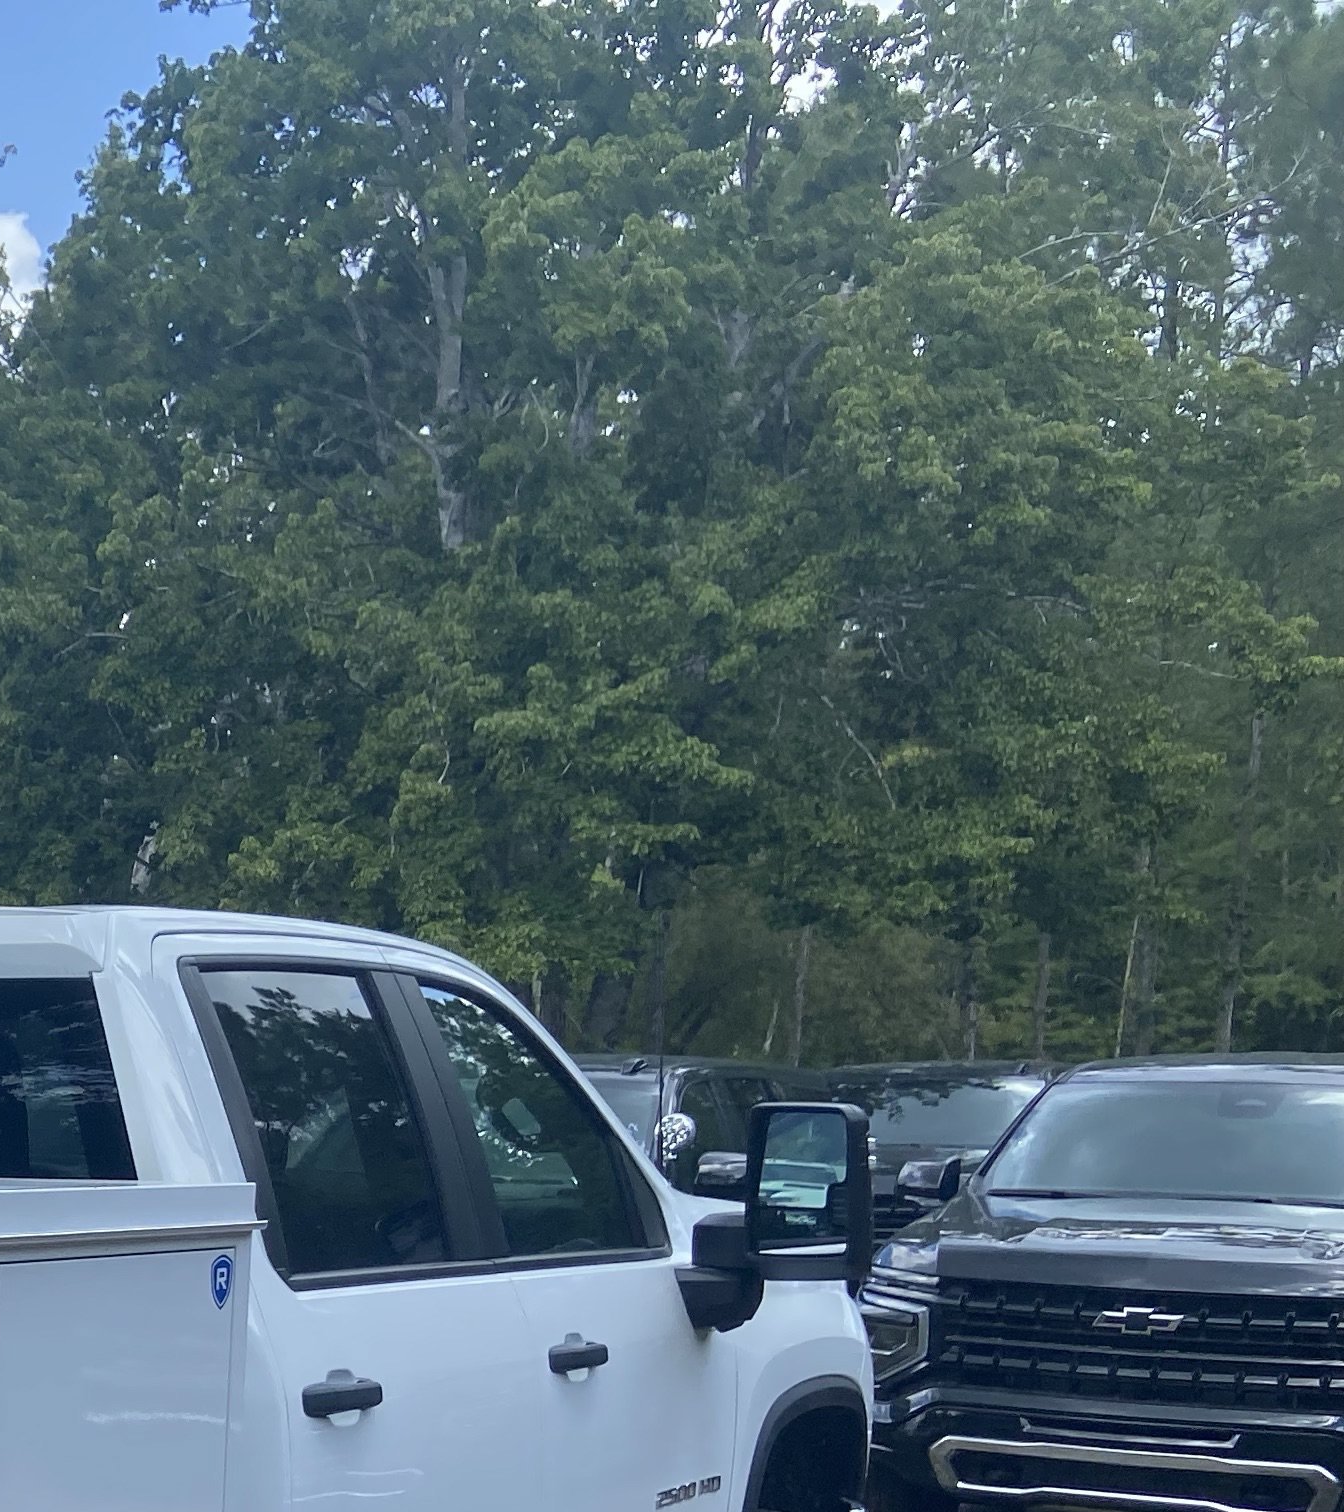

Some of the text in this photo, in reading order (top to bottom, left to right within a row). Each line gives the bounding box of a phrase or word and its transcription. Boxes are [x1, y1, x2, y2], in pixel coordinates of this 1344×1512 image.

[216, 1267, 228, 1291] R
[655, 1475, 722, 1511] 2500 HD
